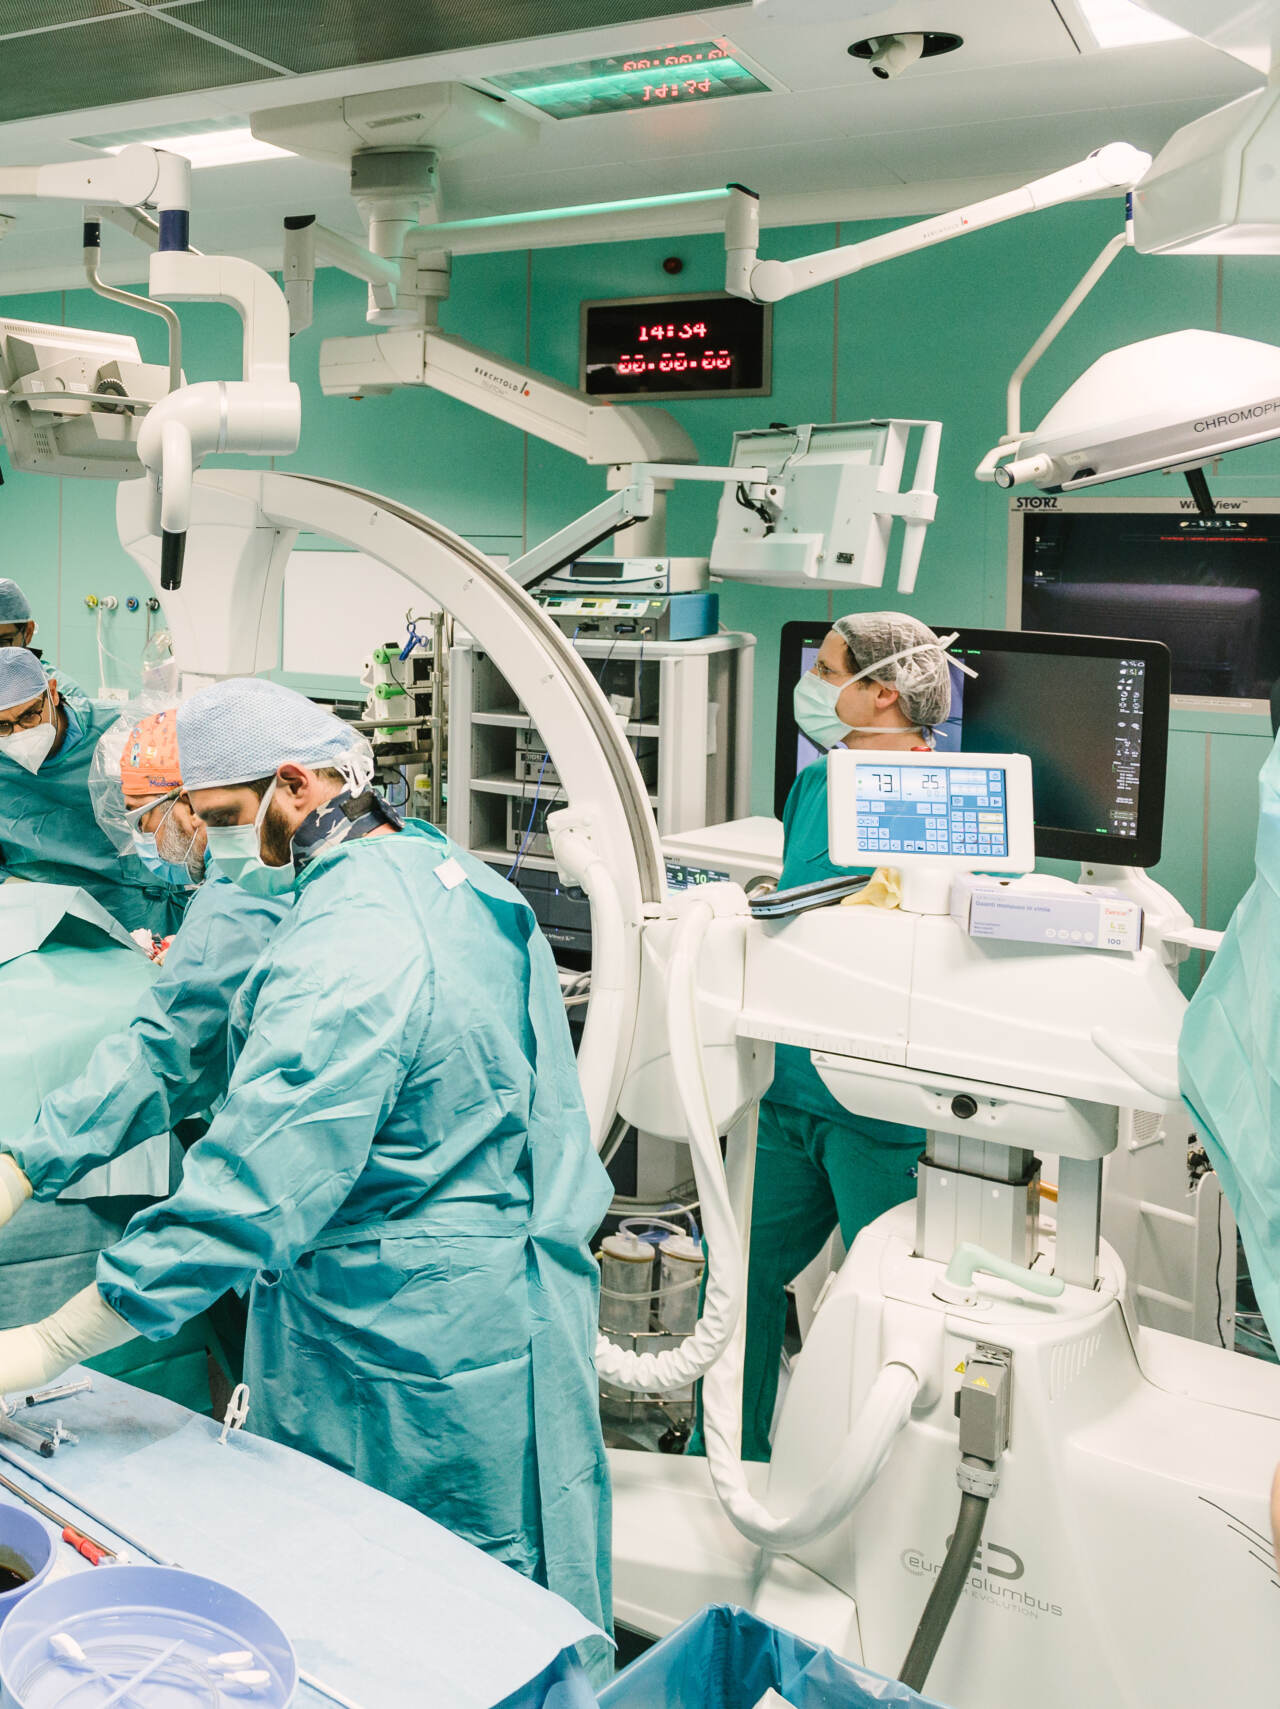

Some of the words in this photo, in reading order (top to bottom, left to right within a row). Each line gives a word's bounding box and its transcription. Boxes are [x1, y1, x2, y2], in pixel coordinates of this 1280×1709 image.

[1016, 496, 1058, 508] STORZ
[871, 773, 893, 793] 73
[922, 774, 939, 789] 25
